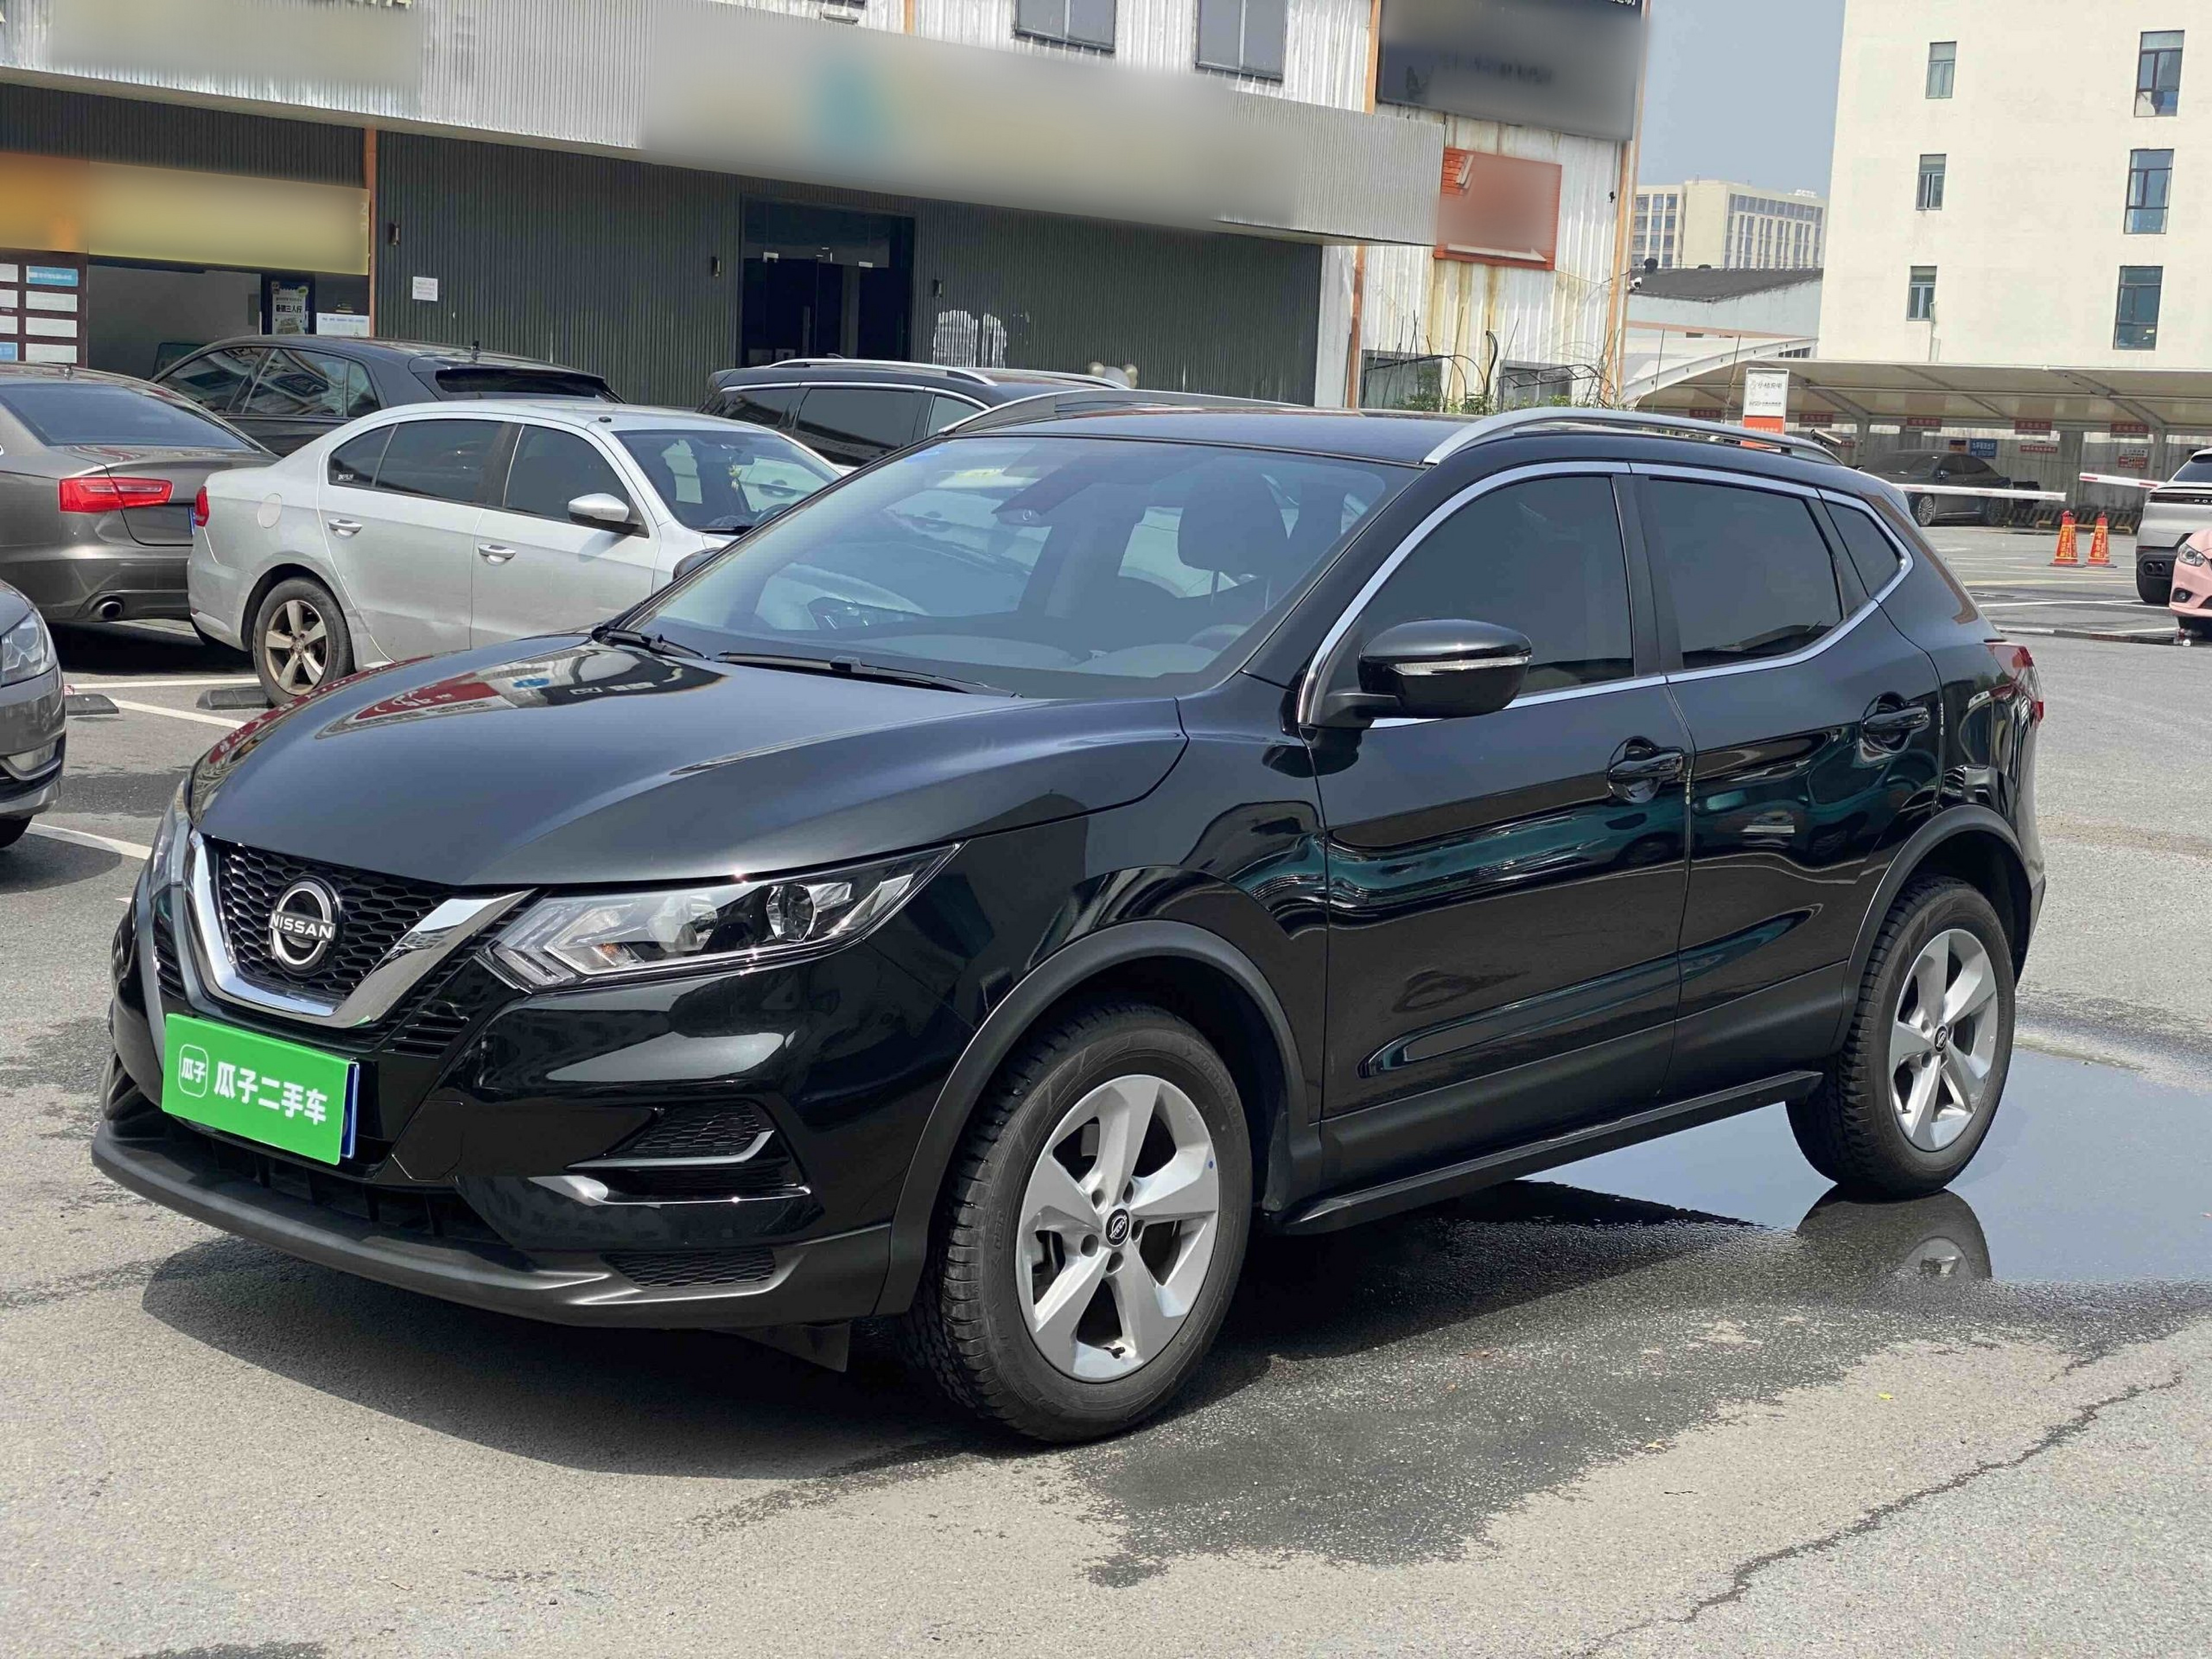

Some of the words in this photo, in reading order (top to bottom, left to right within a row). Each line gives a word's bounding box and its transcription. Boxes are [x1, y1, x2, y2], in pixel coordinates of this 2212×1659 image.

[271, 912, 332, 939] NISSAN
[181, 1058, 206, 1084] 瓜子
[214, 1061, 328, 1125] 瓜子二手车
